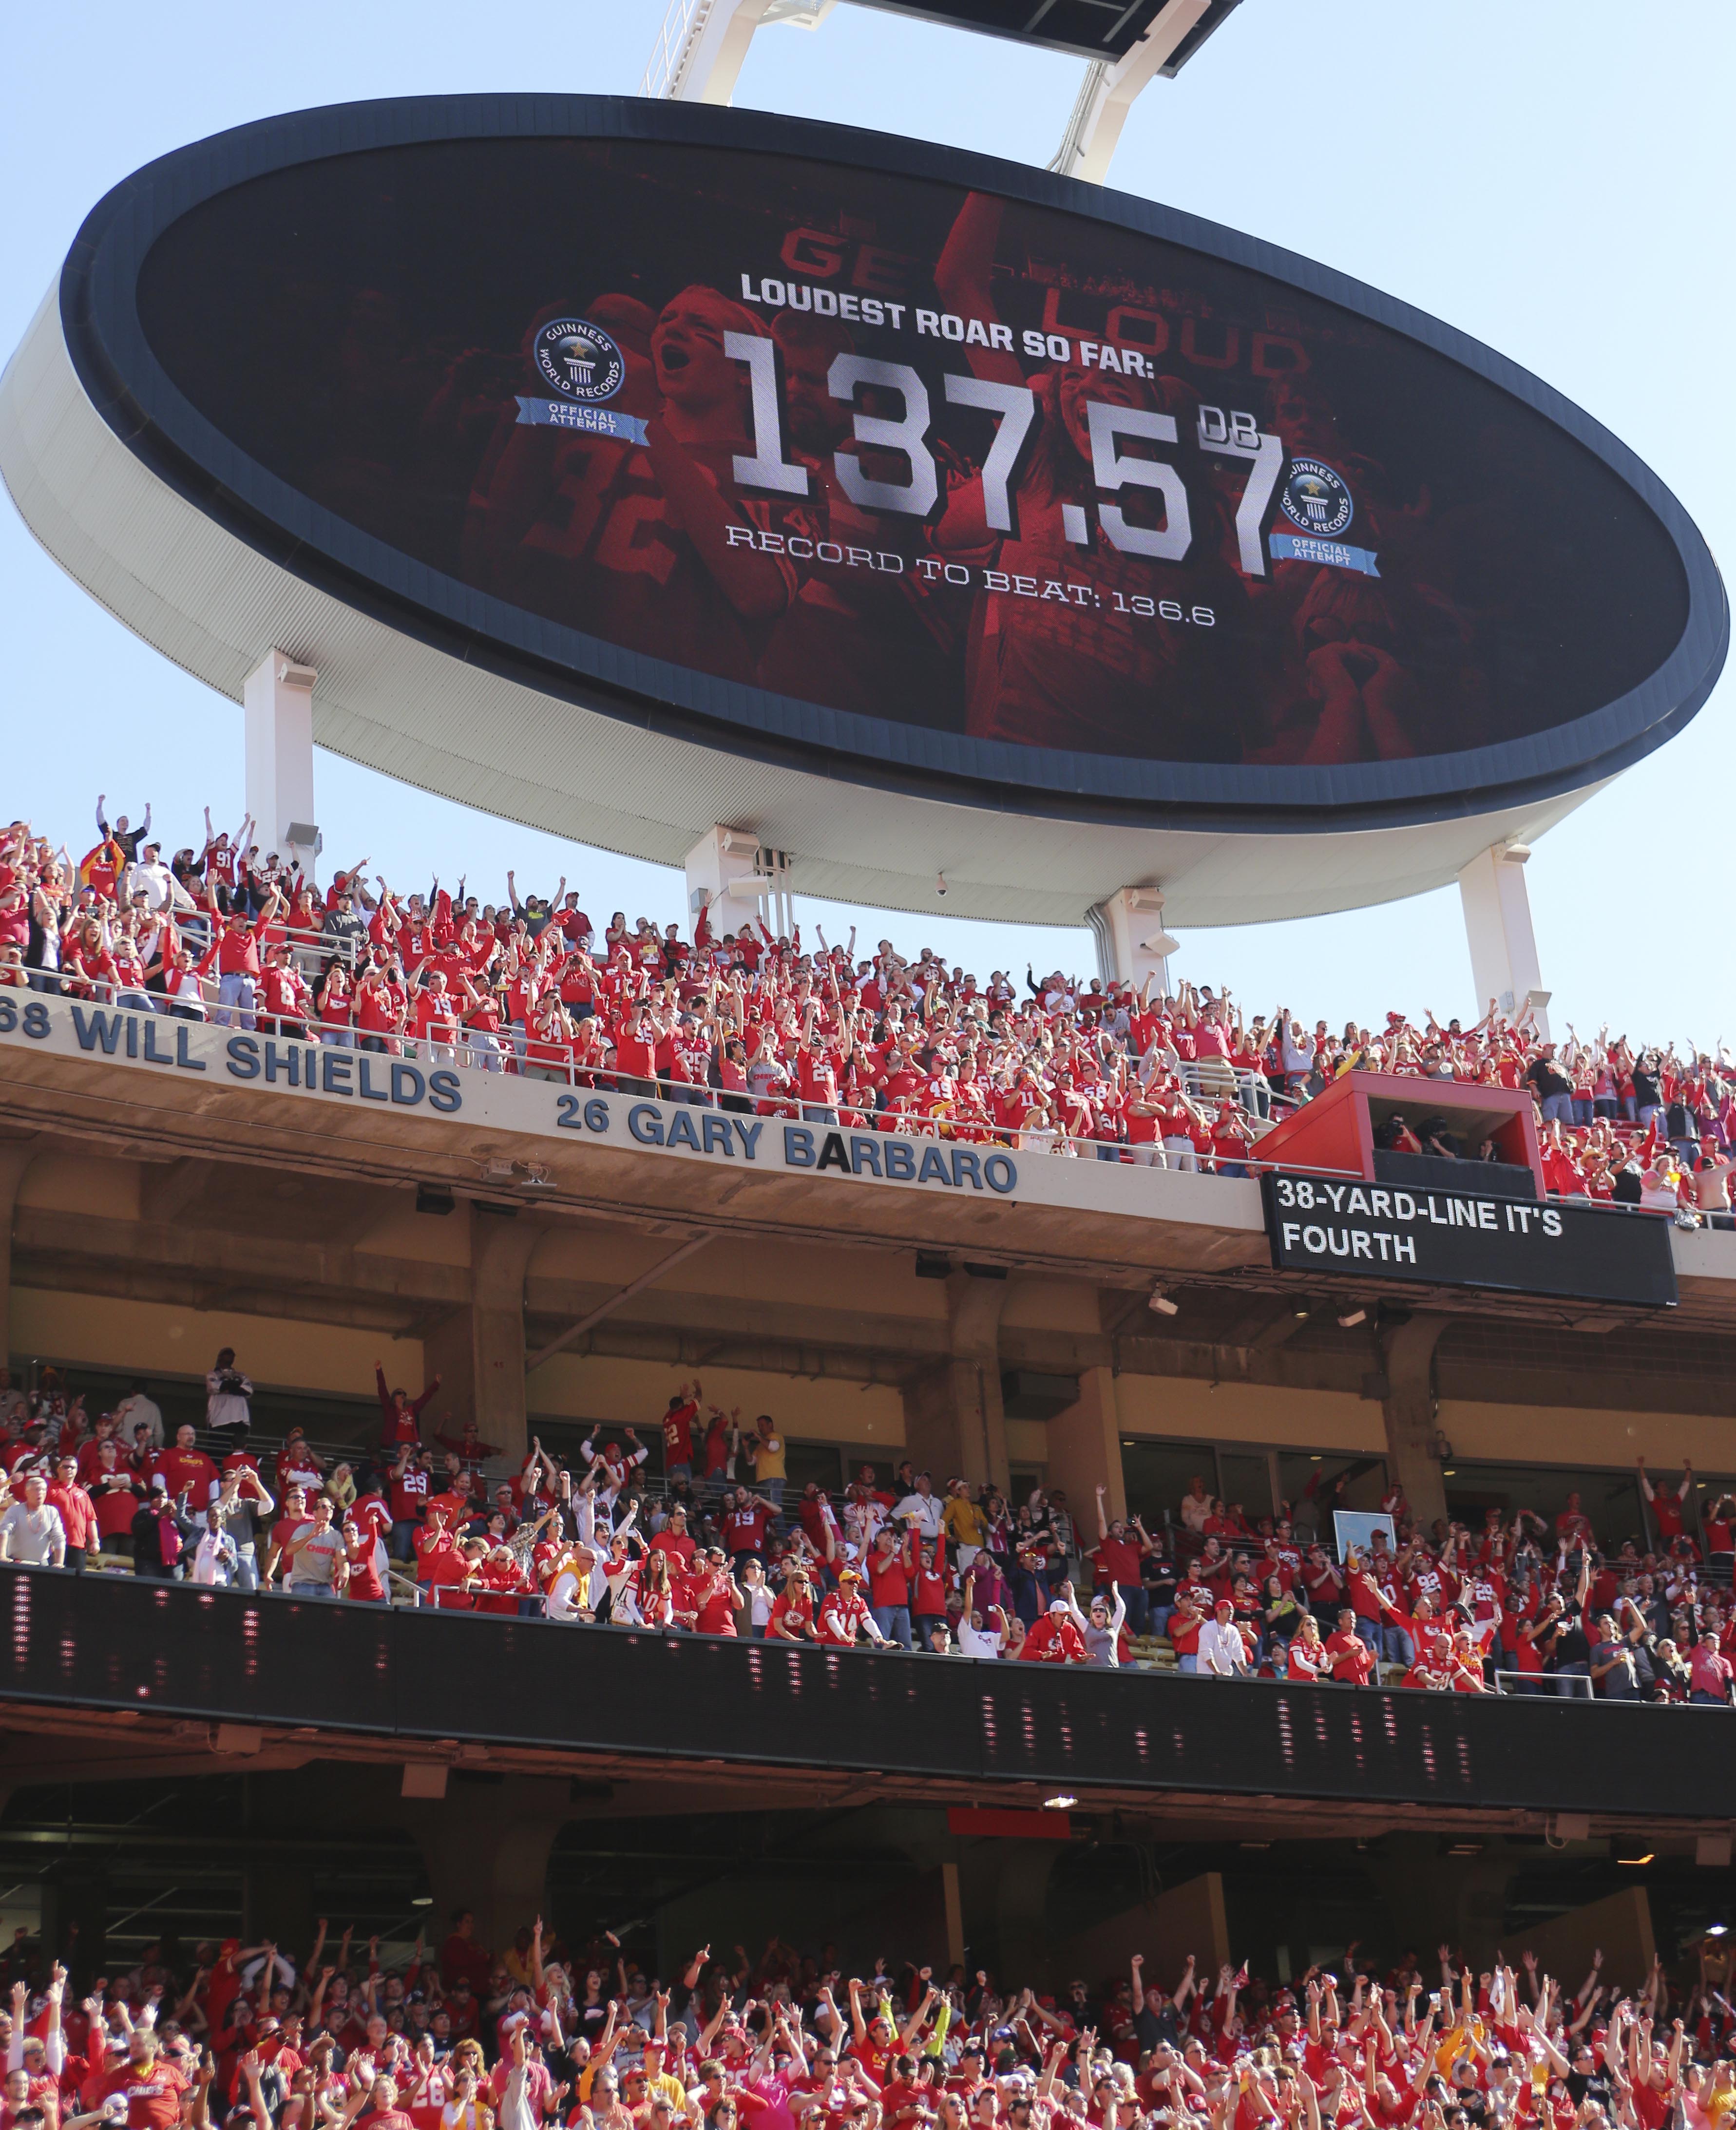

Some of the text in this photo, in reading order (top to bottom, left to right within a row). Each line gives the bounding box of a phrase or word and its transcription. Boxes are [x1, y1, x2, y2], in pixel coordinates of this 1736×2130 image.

[546, 323, 612, 351] GUINNESS
[741, 273, 1154, 379] LOUDEST ROAR SO FAR:
[1042, 288, 1311, 377] LOUD
[539, 348, 619, 397] WORLD RECORDS
[549, 403, 616, 424] OFFICIAL
[550, 414, 616, 433] ATTEMPT
[1198, 404, 1261, 449] DB
[1290, 463, 1340, 488] UINNESS
[1314, 497, 1349, 532] RECORDS
[1292, 538, 1351, 556] OFFICIAL
[1294, 548, 1351, 566] ATTEMPT
[725, 525, 1216, 627] RECORD TO BEAT: 136.6
[217, 852, 230, 869] 91
[434, 998, 453, 1015] 19
[540, 1022, 562, 1043] 34
[71, 1006, 206, 1070] WILL
[226, 1036, 462, 1112] SHIELDS
[930, 1081, 952, 1099] 49
[1021, 1091, 1034, 1106] 11
[1084, 1086, 1106, 1100] 58
[557, 1094, 1017, 1194] 26 GARY BARBARO
[1277, 1179, 1563, 1236] 38-YARD-LINE IT'S
[1282, 1222, 1416, 1264] FOURTH
[403, 1473, 427, 1495] 29
[735, 1511, 754, 1527] 19
